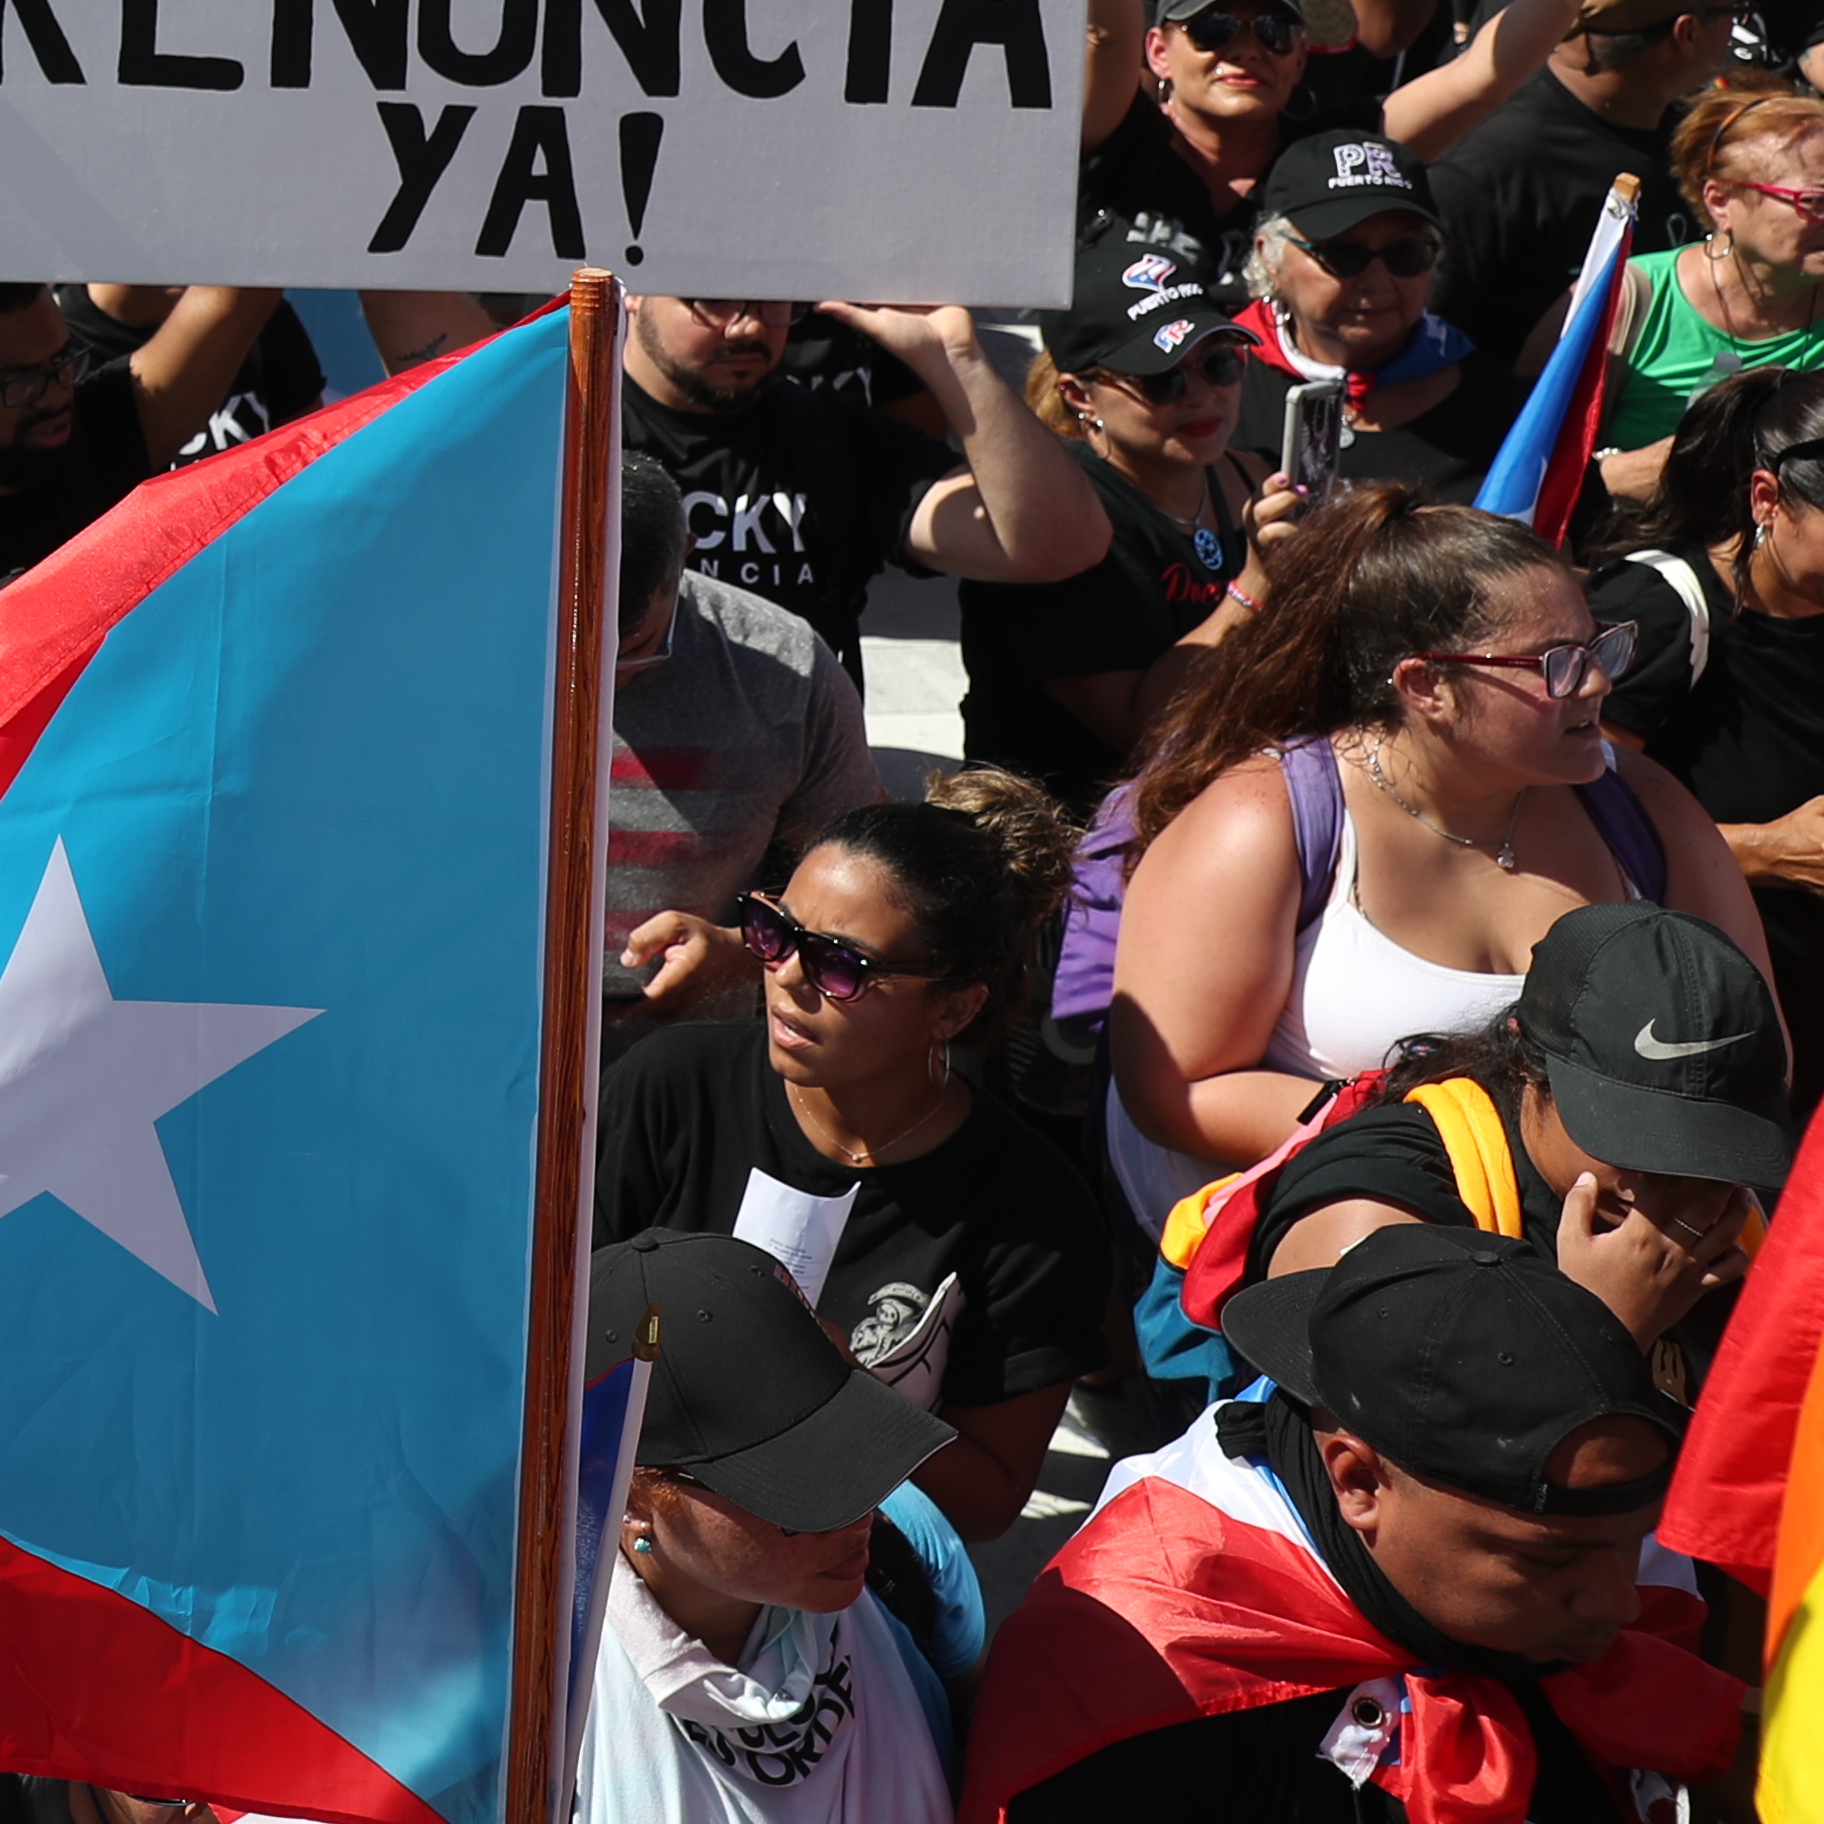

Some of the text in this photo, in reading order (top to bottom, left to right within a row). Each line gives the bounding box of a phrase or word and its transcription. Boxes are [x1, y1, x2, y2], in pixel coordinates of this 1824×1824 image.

[1332, 140, 1402, 178] PR
[366, 101, 666, 267] YA!
[1327, 174, 1384, 190] PUERTO
[1126, 285, 1180, 322] PUERTO
[682, 490, 808, 555] CKY
[699, 557, 815, 587] NCIA
